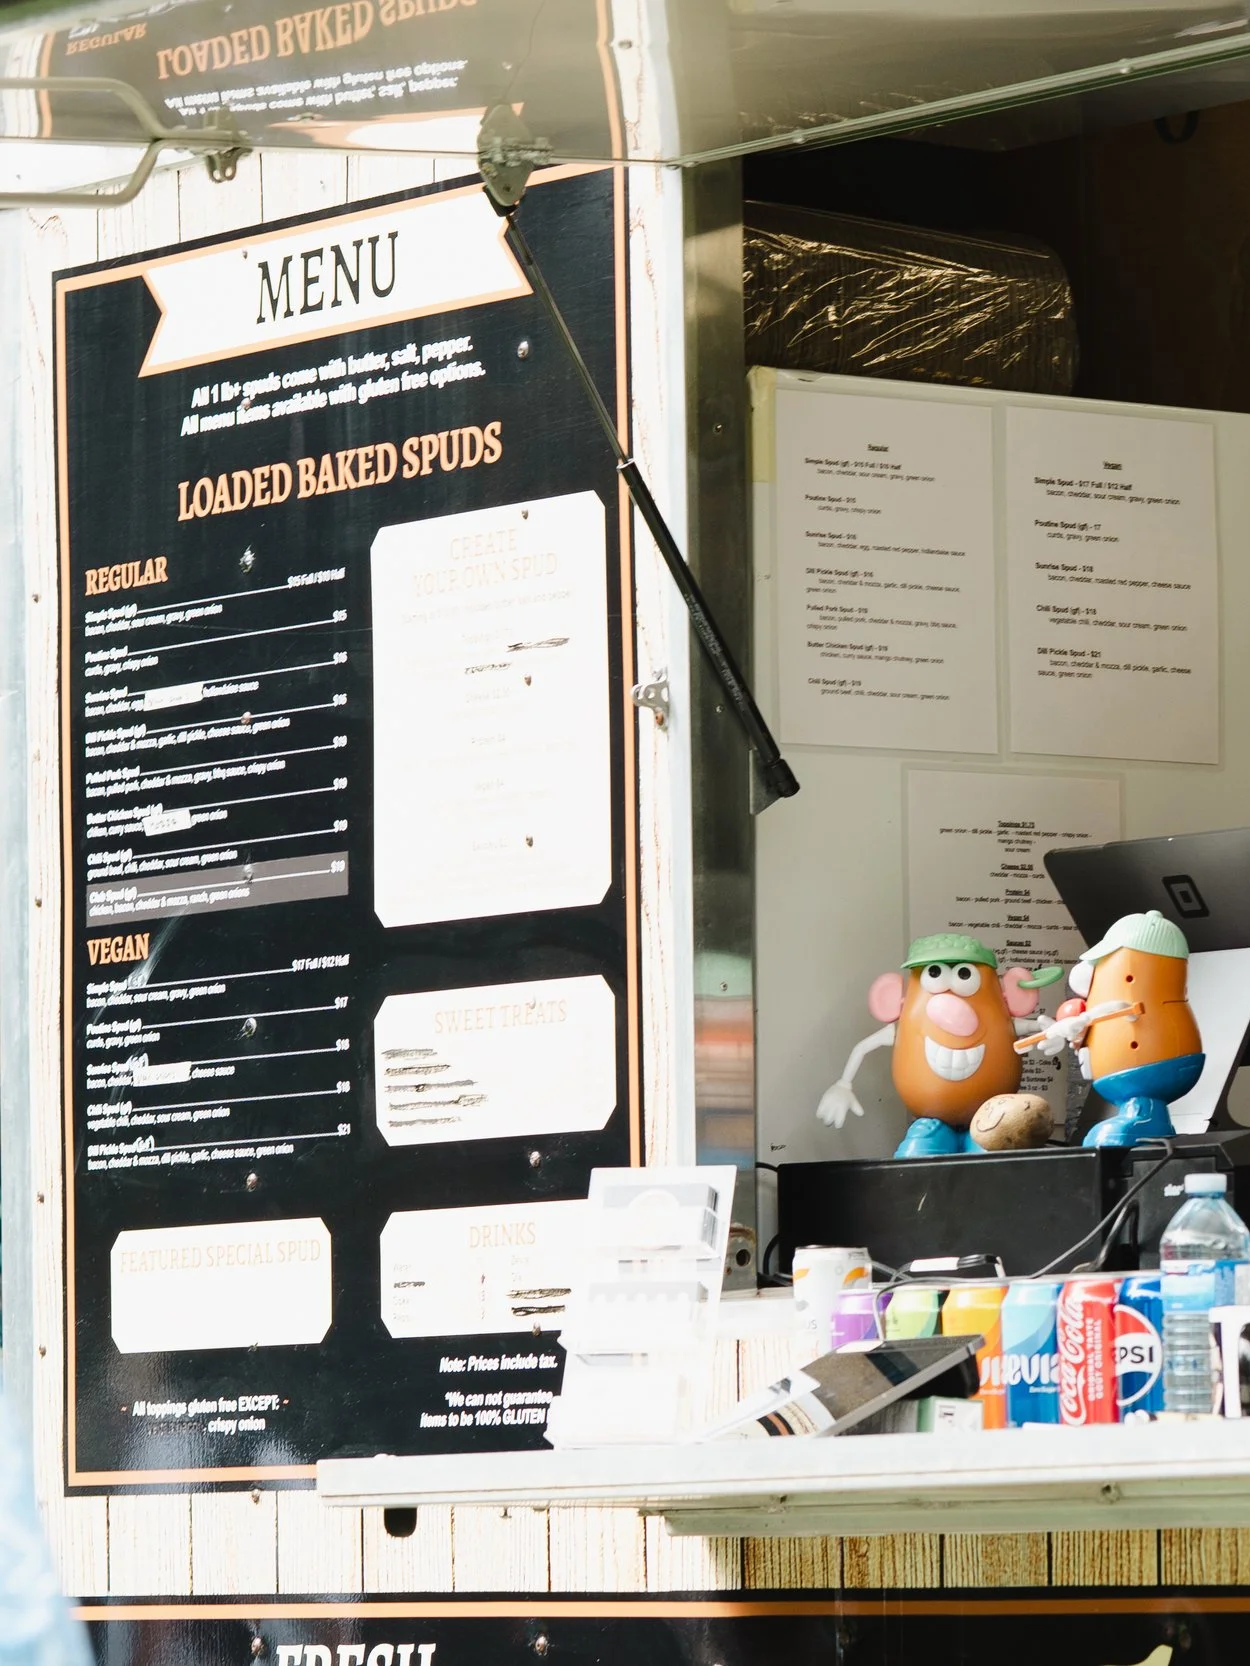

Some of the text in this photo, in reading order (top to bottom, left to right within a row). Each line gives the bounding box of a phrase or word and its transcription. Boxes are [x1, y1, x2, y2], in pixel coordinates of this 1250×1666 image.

[256, 231, 398, 324] MENU
[191, 336, 473, 408] All 1 lb+ spuds come with butter, salt, pepper.
[180, 360, 486, 436] All menu items available with gluten free options.
[178, 421, 503, 522] LOADED BAKED SPUDS
[451, 529, 517, 560] CREATE
[85, 556, 168, 596] REGULAR
[414, 553, 558, 597] YOUR OWN SPUD
[86, 933, 150, 966] VEGAN
[334, 997, 348, 1009] $17
[435, 1000, 567, 1033] SWEET TREATS
[469, 1222, 536, 1248] DRINKS
[120, 1239, 321, 1272] FEATURED SPECIAL SPUD
[440, 1353, 558, 1372] Note: Prices include tax.
[132, 1395, 280, 1418] All toppings gluten free EXCEPT:
[464, 1393, 484, 1406] can
[485, 1391, 502, 1406] not
[208, 1418, 238, 1435] crispy
[238, 1416, 265, 1431] onion
[419, 1412, 447, 1428] items
[448, 1412, 459, 1427] to
[460, 1411, 473, 1426] be
[475, 1410, 501, 1425] 100%
[503, 1408, 547, 1425] GLUTEN
